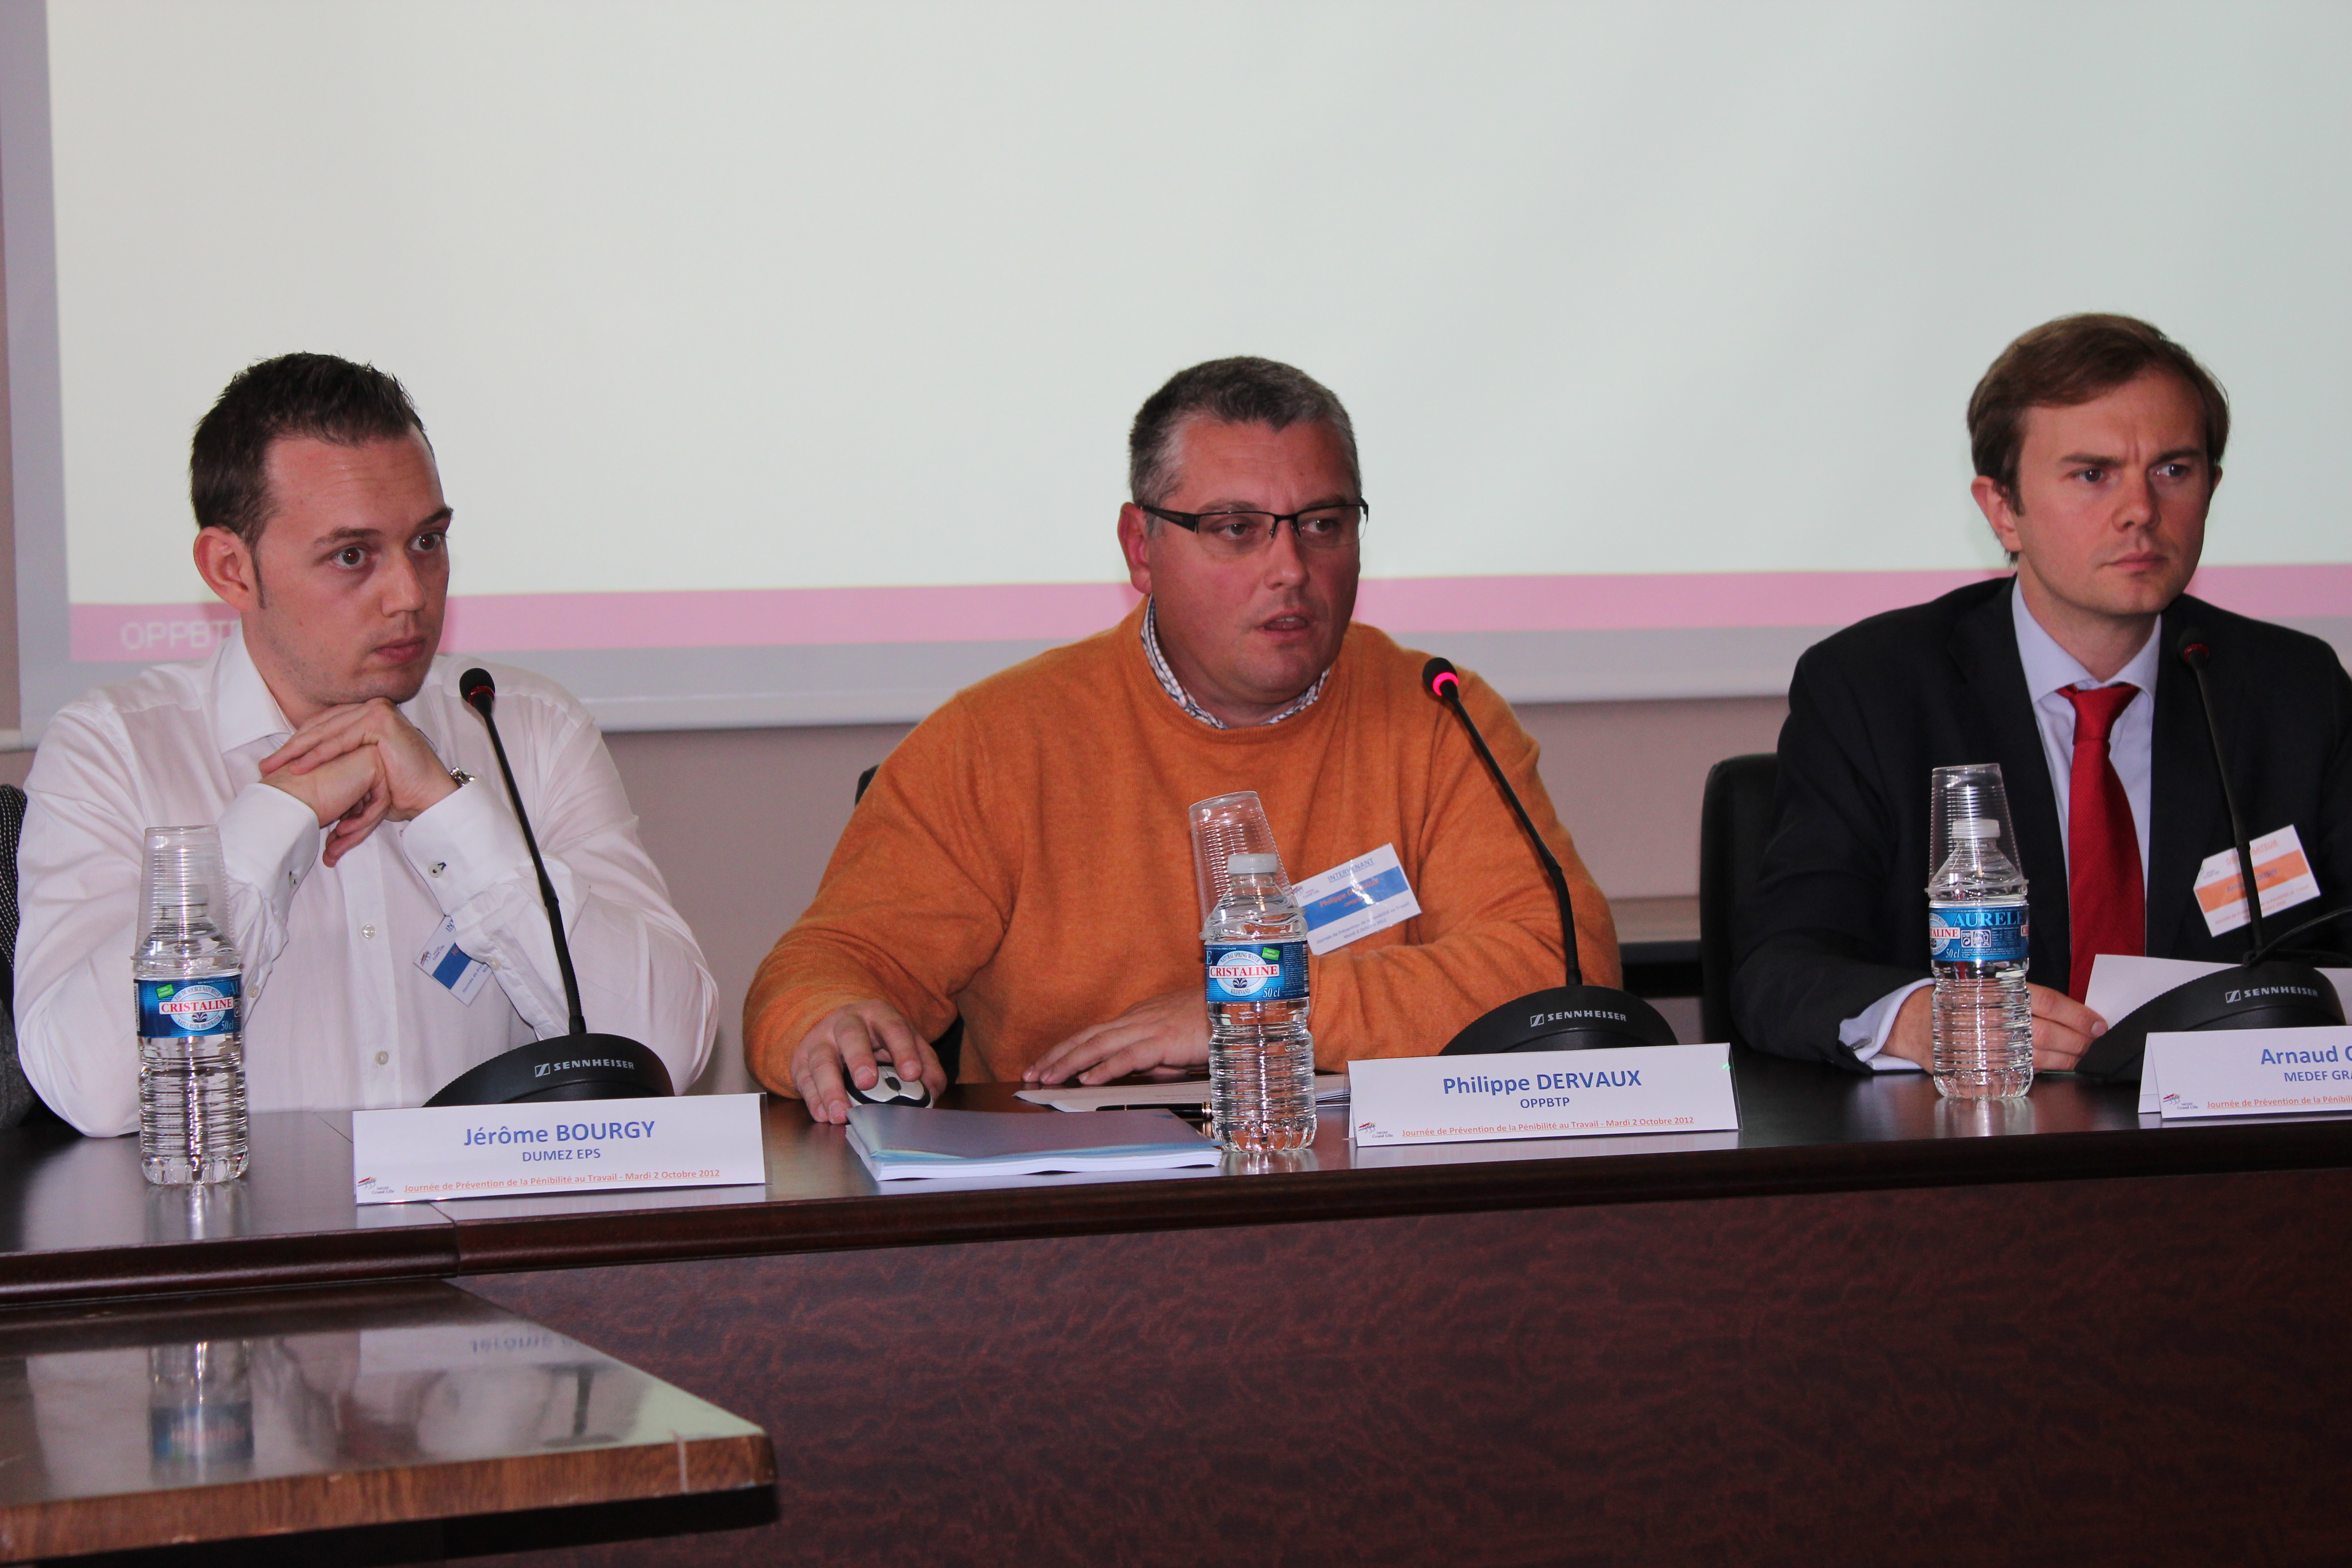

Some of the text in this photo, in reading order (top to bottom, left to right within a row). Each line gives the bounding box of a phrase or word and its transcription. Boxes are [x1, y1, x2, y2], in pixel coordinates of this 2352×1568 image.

[1220, 952, 1234, 964] NATURAL
[1248, 954, 1260, 963] WATER
[1210, 965, 1278, 977] CRISTALINE
[187, 986, 202, 995] SOURCE
[202, 986, 221, 998] NATURELLE
[1263, 987, 1271, 998] 50
[1273, 987, 1280, 997] cl
[2244, 986, 2318, 998] SENNHEISER
[161, 998, 232, 1013] CRISTALINE
[1548, 1010, 1627, 1022] SENNHEISER
[2261, 1045, 2339, 1064] Arnaud
[554, 1059, 635, 1072] SENNHEISER
[1443, 1070, 1642, 1095] Philippe DERVAUX
[2284, 1071, 2328, 1082] MEDEF
[1520, 1097, 1570, 1108] OPPBTP
[2254, 1098, 2299, 1106] Prévention
[1402, 1128, 1435, 1137] Journée
[1450, 1124, 1494, 1134] Prévention
[1518, 1122, 1557, 1131] Pénibilité
[1571, 1120, 1599, 1128] Travail
[1606, 1118, 1630, 1127] Mardi
[1640, 1117, 1672, 1126] Octobre
[464, 1121, 655, 1146] Jérôme BOURGY
[522, 1148, 601, 1162] DUMEZ EPS
[404, 1183, 440, 1193] Journée
[442, 1181, 453, 1190] de
[456, 1180, 504, 1189] Prévention
[530, 1175, 572, 1185] Pénibilité
[588, 1173, 617, 1182] Travail
[625, 1172, 651, 1180] Mardi
[661, 1170, 696, 1179] Octobre
[699, 1169, 720, 1177] 2012
